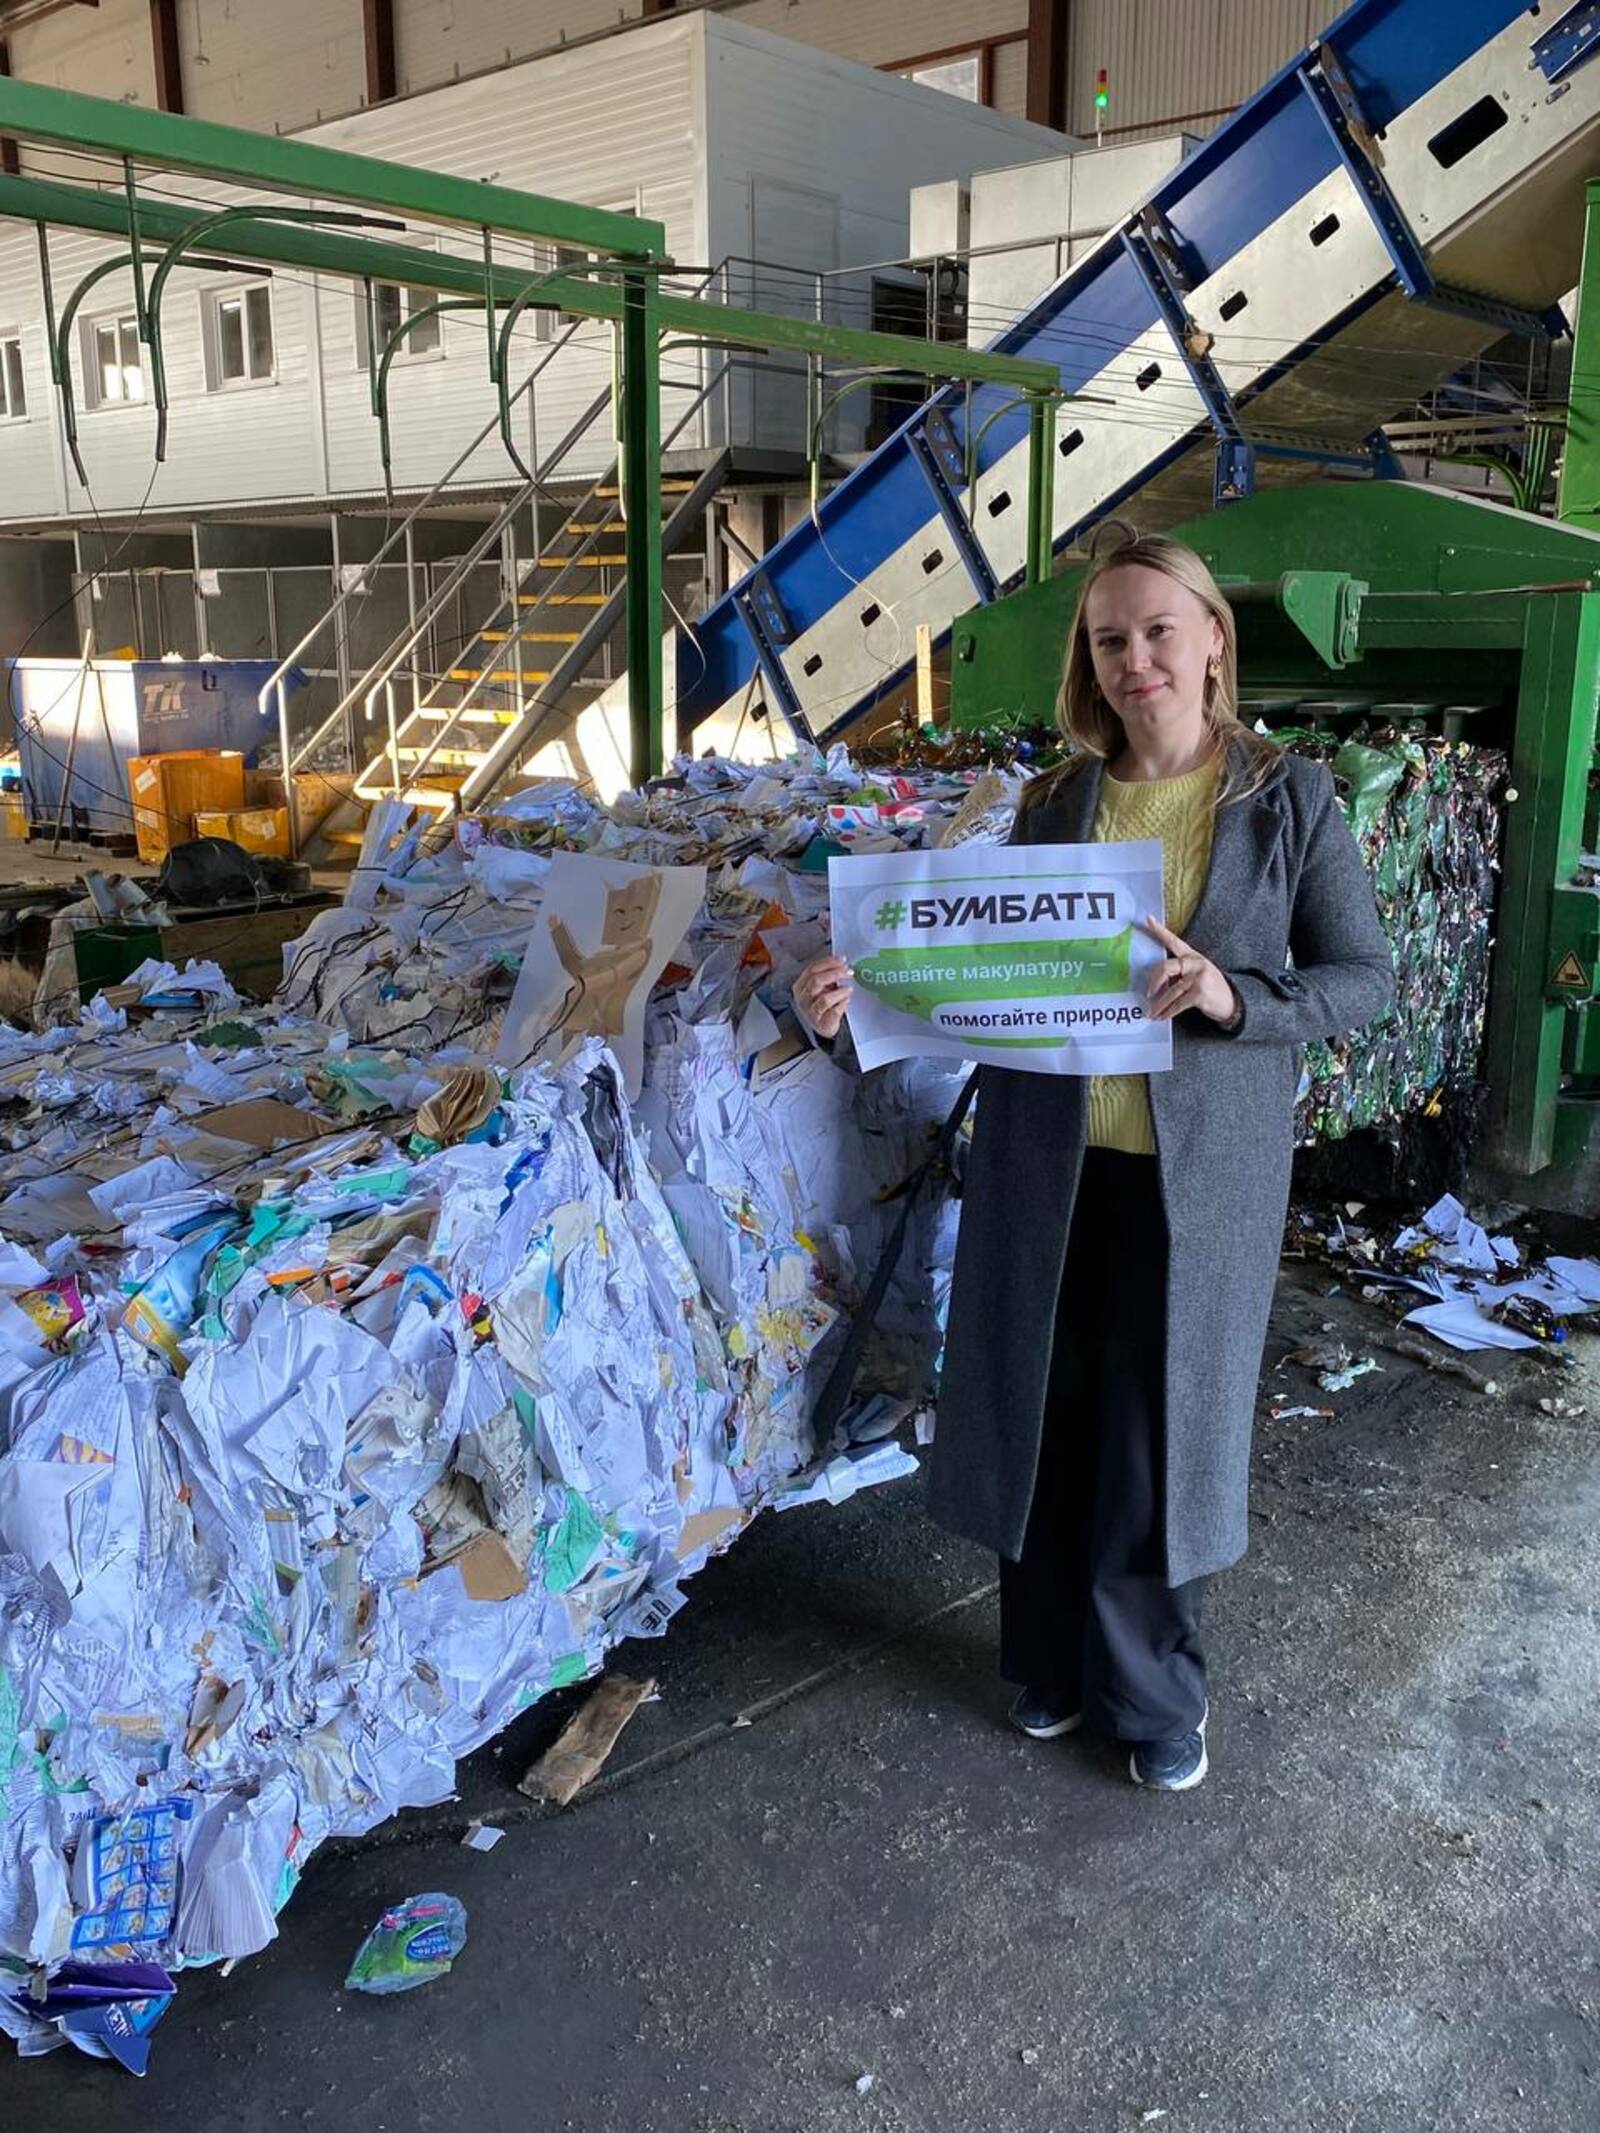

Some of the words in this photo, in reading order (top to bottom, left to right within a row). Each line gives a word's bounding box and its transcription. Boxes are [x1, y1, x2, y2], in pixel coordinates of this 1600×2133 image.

[861, 964, 956, 986] Сдавайте
[962, 957, 1083, 983] макулатуру
[940, 1007, 1047, 1028] помогайте
[1053, 1006, 1142, 1027] природе
